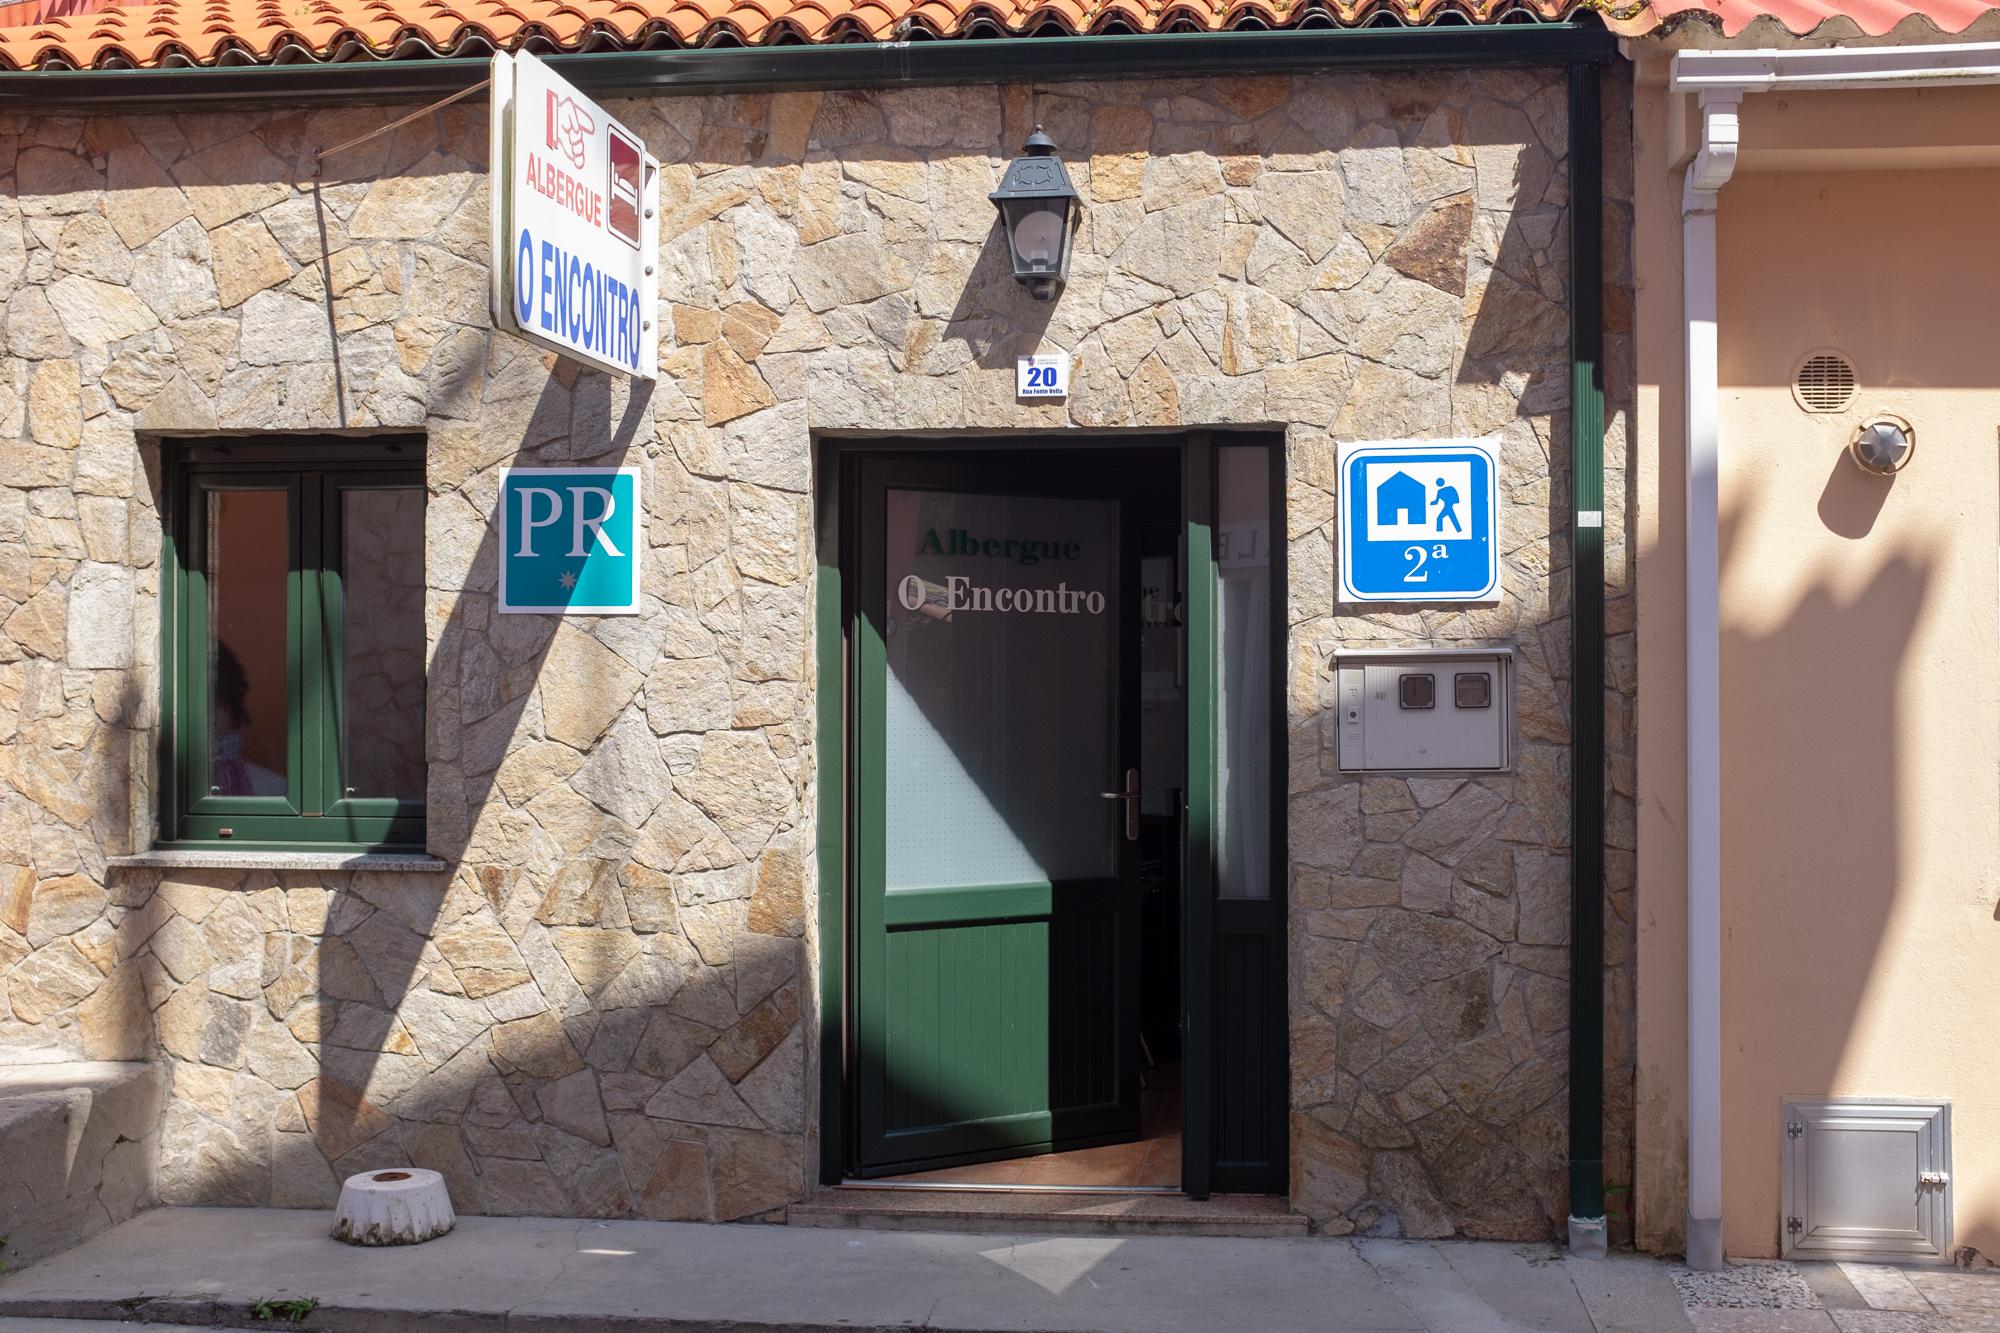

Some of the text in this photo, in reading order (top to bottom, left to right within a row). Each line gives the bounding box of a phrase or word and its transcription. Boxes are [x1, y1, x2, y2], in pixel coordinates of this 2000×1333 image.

[526, 152, 602, 229] ALBERGUE
[518, 228, 641, 370] O ENCONTRO
[1027, 367, 1057, 387] 20
[513, 486, 626, 557] PR
[917, 527, 1081, 566] Albergue
[898, 574, 926, 611] O
[944, 575, 1106, 615] Encontro
